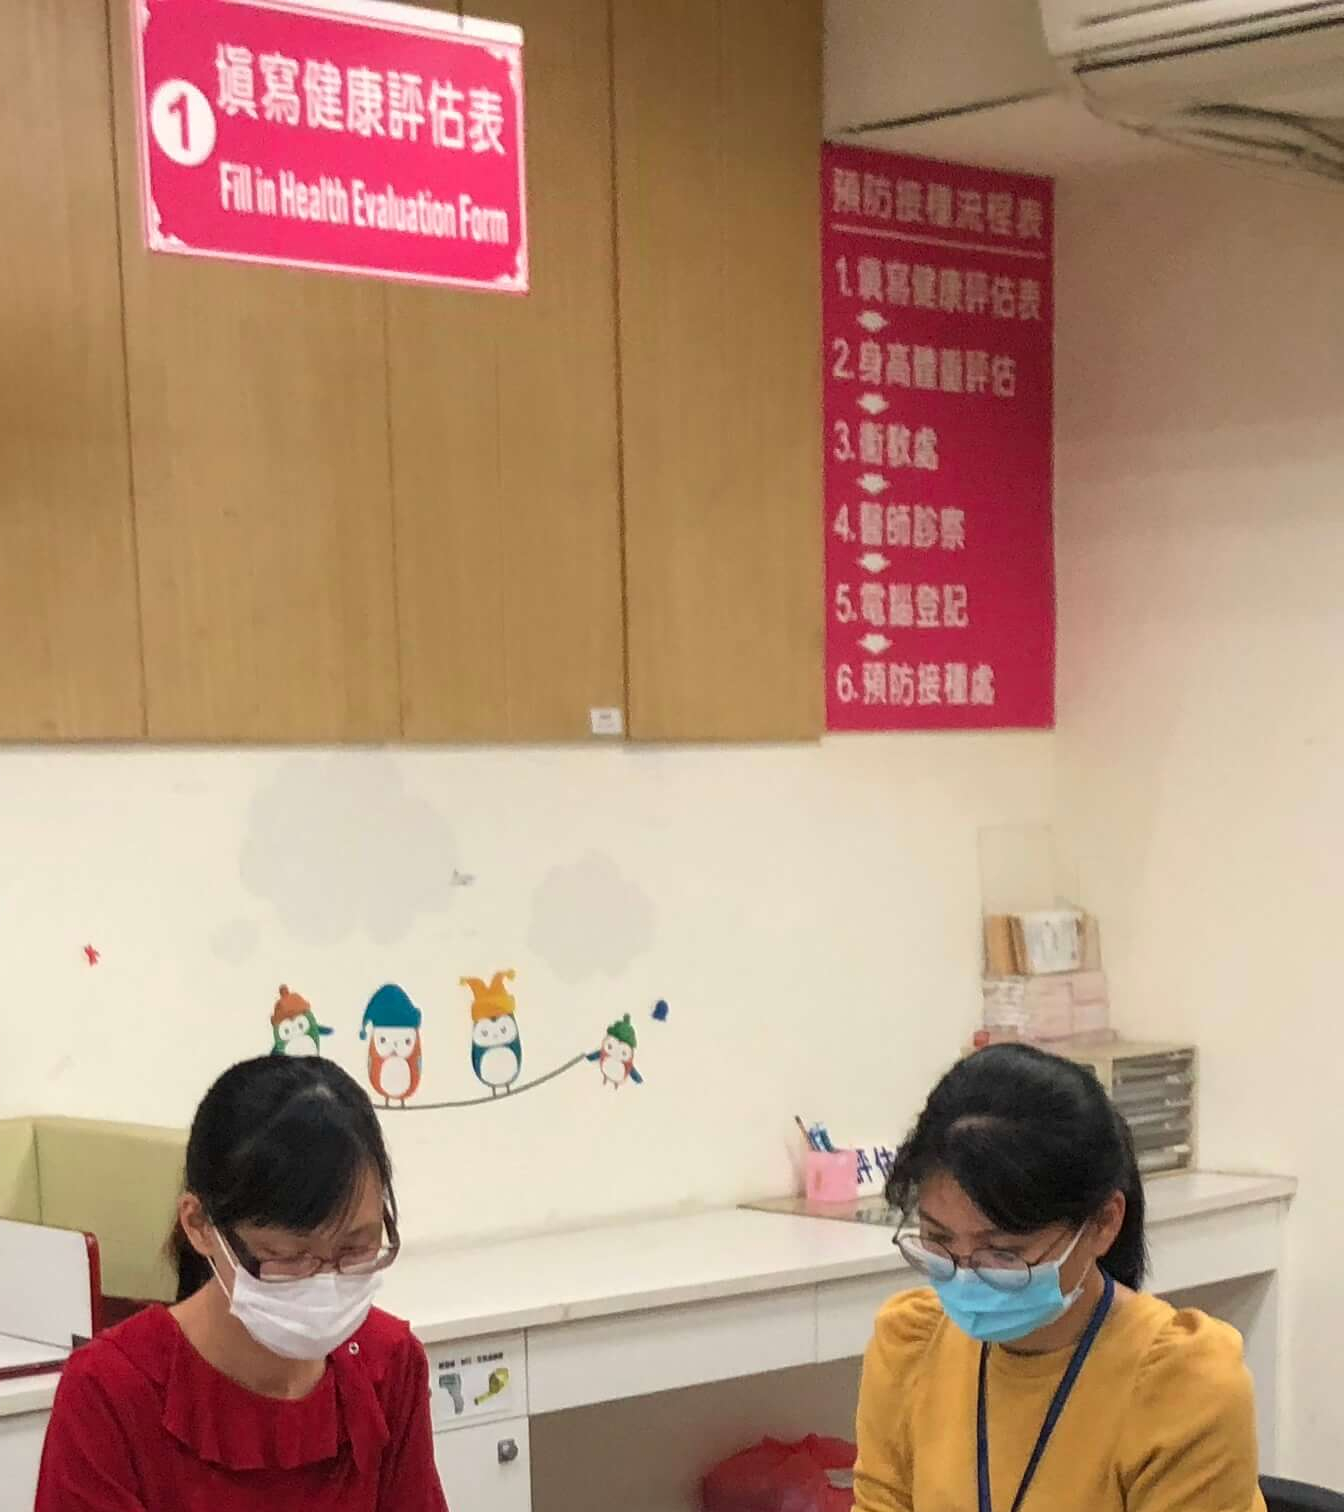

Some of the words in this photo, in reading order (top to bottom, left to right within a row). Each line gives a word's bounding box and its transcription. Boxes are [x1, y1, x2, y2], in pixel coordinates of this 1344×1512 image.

[168, 92, 191, 152] 1
[219, 161, 252, 212] Fill
[256, 167, 275, 215] in
[279, 170, 348, 225] Health
[353, 180, 456, 239] Evaluation
[459, 194, 510, 244] Form
